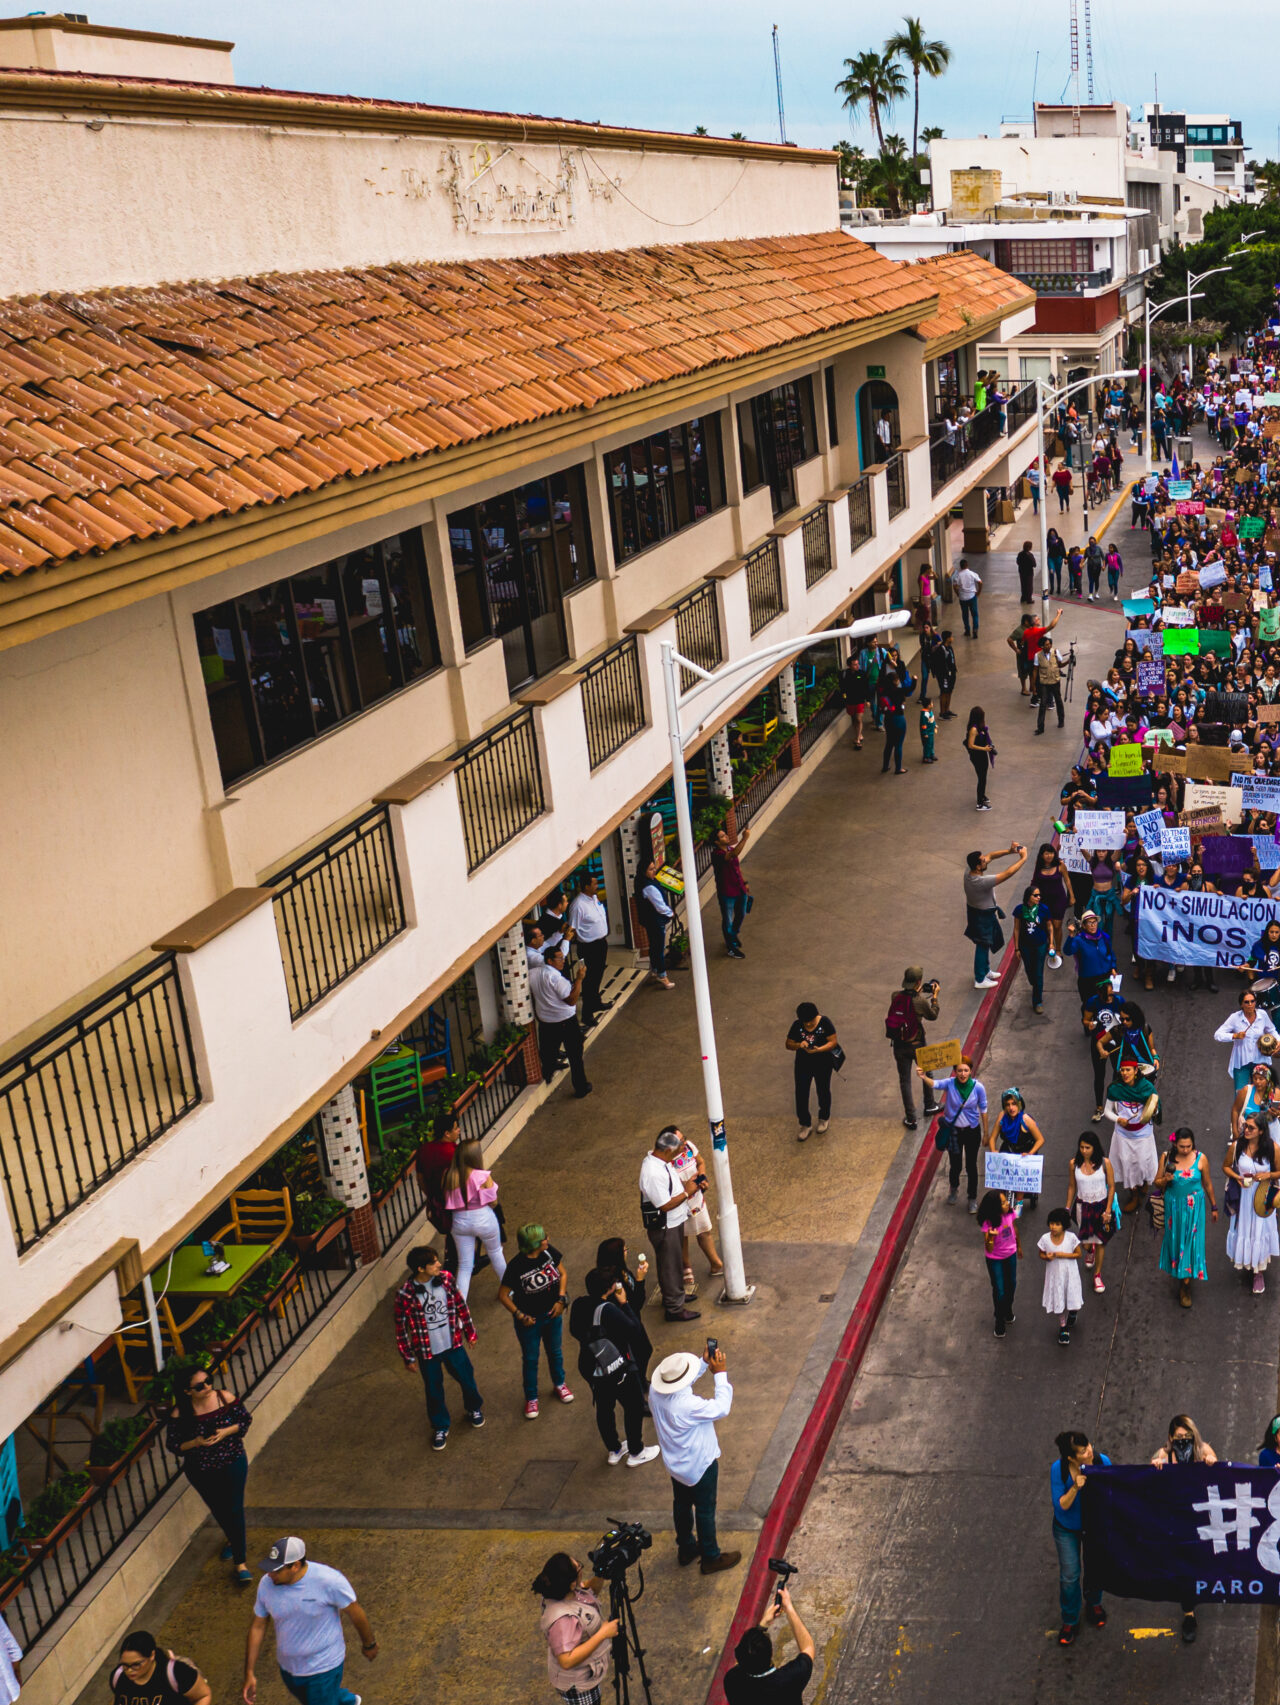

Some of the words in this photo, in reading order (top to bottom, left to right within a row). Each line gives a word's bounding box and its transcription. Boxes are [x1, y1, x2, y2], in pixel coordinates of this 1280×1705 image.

[1234, 775, 1244, 783] NO
[1143, 821, 1159, 835] NO
[1181, 895, 1276, 922] SIMULACIÓN
[1161, 920, 1247, 949] ¡NOS
[1195, 1579, 1264, 1595] PARO
